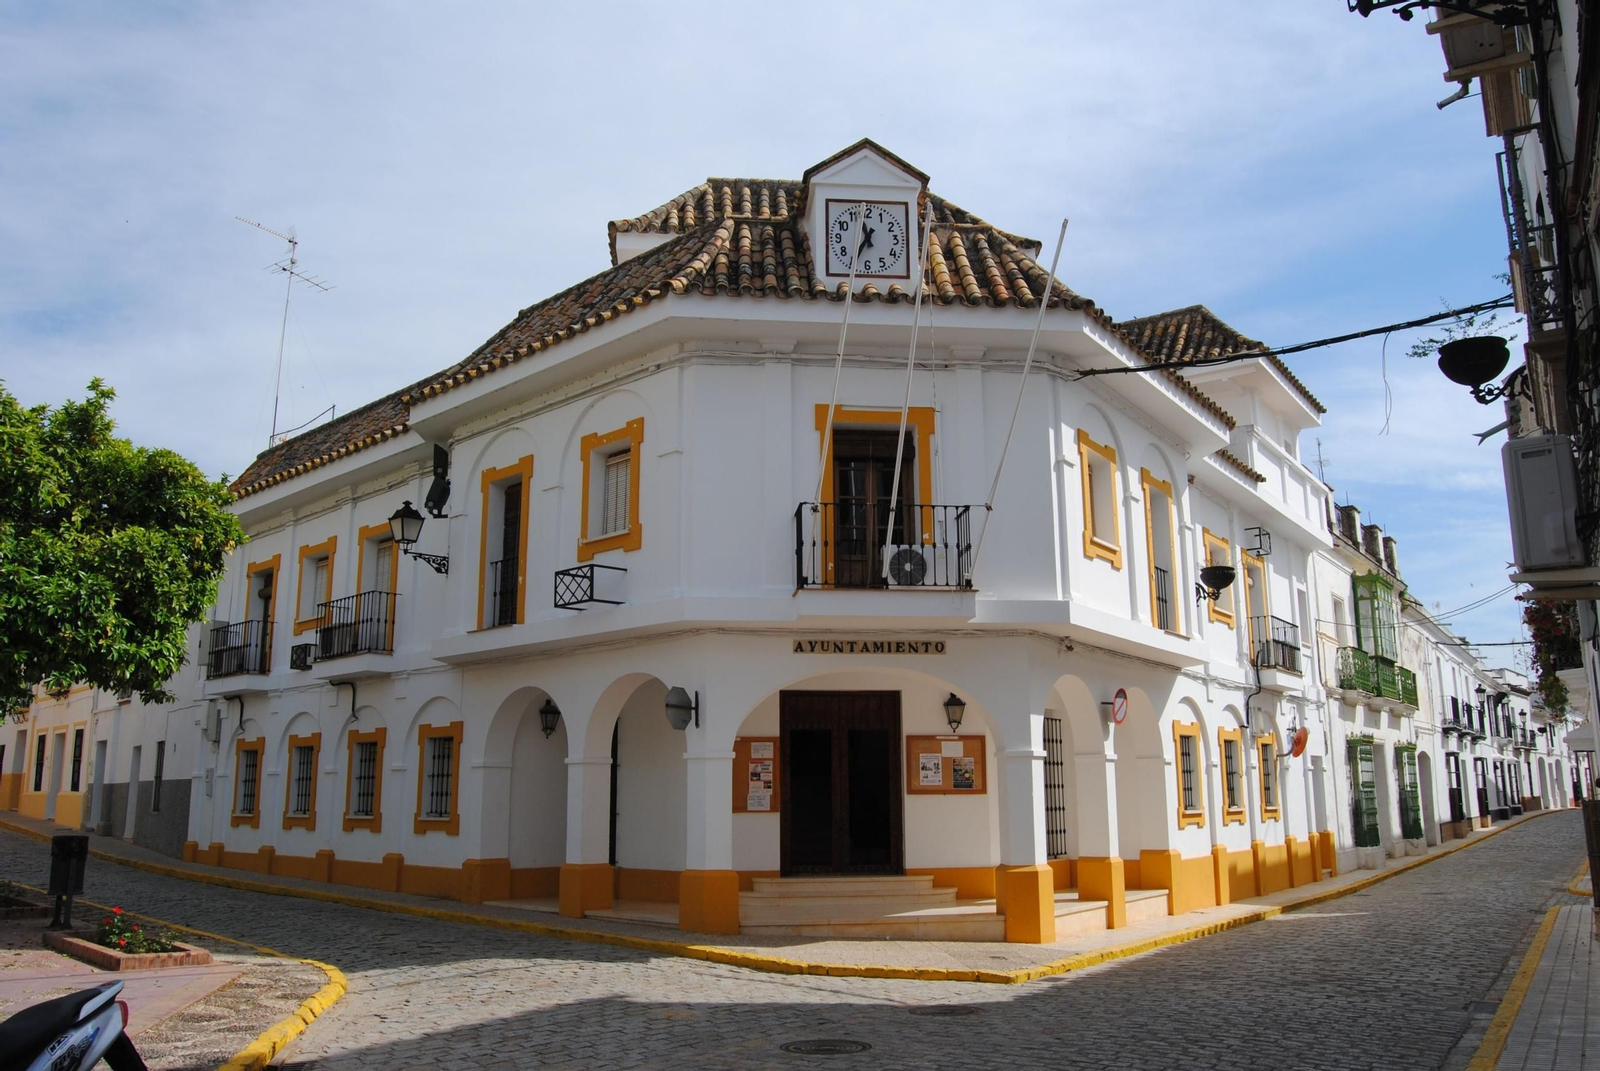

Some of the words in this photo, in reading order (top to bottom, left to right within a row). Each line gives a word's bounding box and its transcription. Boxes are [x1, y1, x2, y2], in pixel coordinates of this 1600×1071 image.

[879, 213, 883, 224] 1
[838, 221, 849, 232] 10
[888, 222, 895, 233] 2
[835, 233, 842, 244] 9
[892, 235, 900, 246] 3
[840, 246, 847, 257] 8
[889, 248, 897, 259] 4
[864, 260, 872, 271] 6
[879, 258, 886, 269] 5
[793, 640, 945, 653] AYUNTAMIENTO
